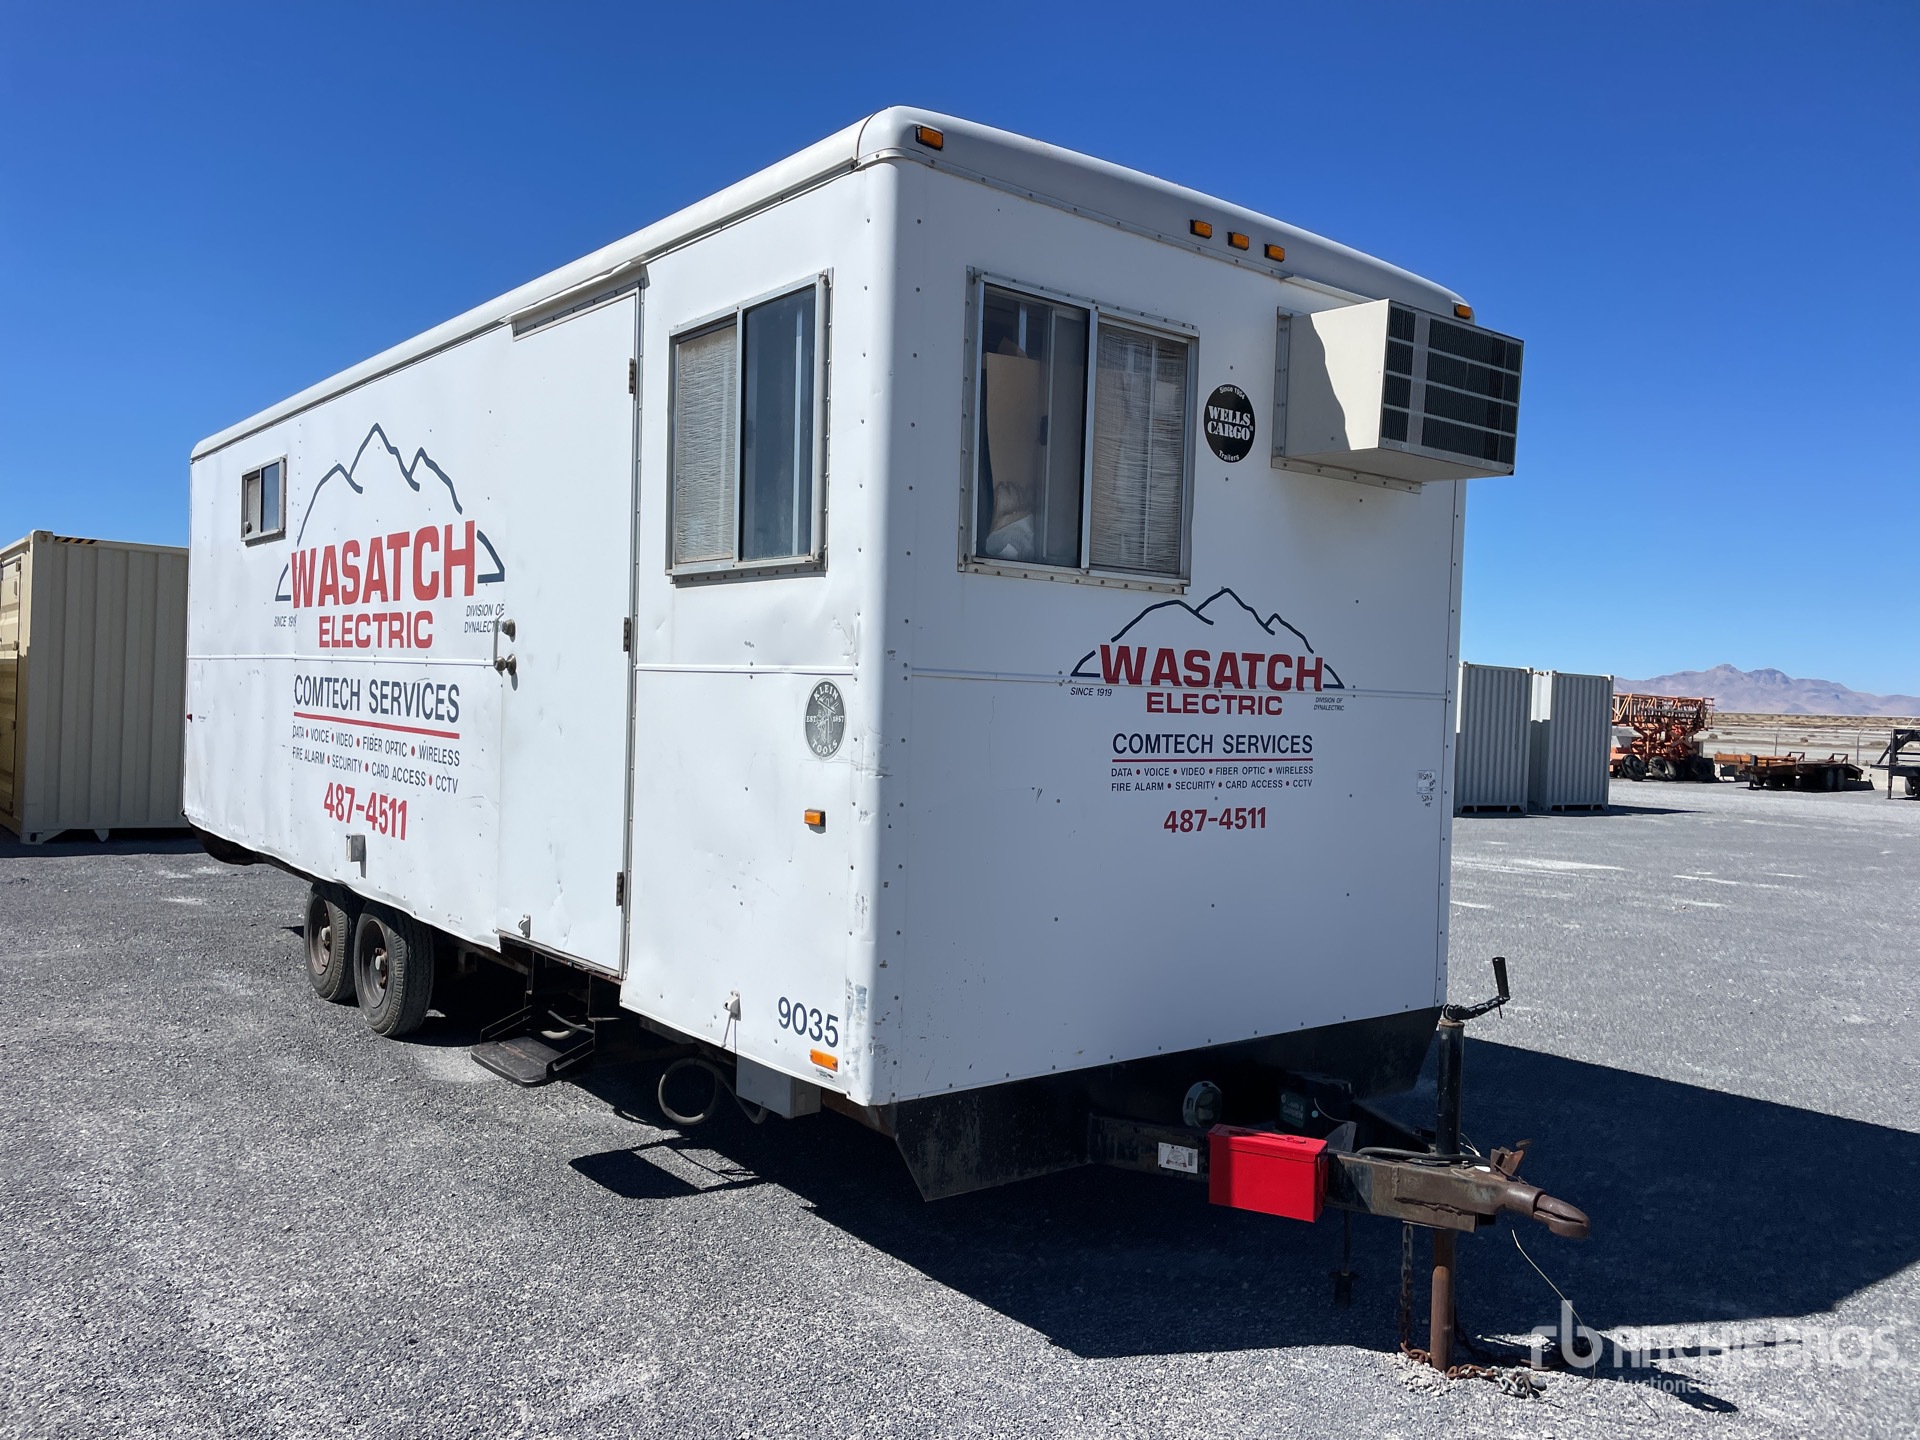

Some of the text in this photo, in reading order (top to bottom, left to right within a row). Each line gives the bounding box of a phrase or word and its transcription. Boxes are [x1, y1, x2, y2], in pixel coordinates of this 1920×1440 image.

[1208, 405, 1251, 426] WELLS
[1207, 421, 1251, 441] CARGO
[1219, 450, 1240, 461] Trailers
[291, 520, 475, 609] WASATCH
[466, 603, 505, 617] DIVISION OF
[319, 611, 433, 649] ELECTRIC
[1100, 644, 1323, 692] WASATCH
[294, 674, 460, 724] COMTECH SERVICES
[813, 684, 839, 701] KLEIN
[1070, 687, 1113, 697] SINCE 1919
[1146, 692, 1283, 716] ELECTRIC
[1313, 704, 1345, 712] DYNALECTRIC
[292, 725, 460, 767] DATA VOICE VIDEO FIBER OPTIC WIRELESS
[812, 739, 838, 755] TOOLS
[1112, 733, 1313, 755] COMTECH SERVICES
[292, 746, 459, 794] FIRE ALARM SECURITY CARD ACCESS CCTV
[1111, 765, 1314, 777] DATA VOICE VIDEO FIBER OPTIC WIRELESS
[1111, 779, 1313, 792] FIRE ALARM SECURITY CARD ACCESS CCTV
[323, 782, 408, 841] 487-4511
[1163, 806, 1267, 834] 487-4511
[777, 996, 839, 1048] 9035
